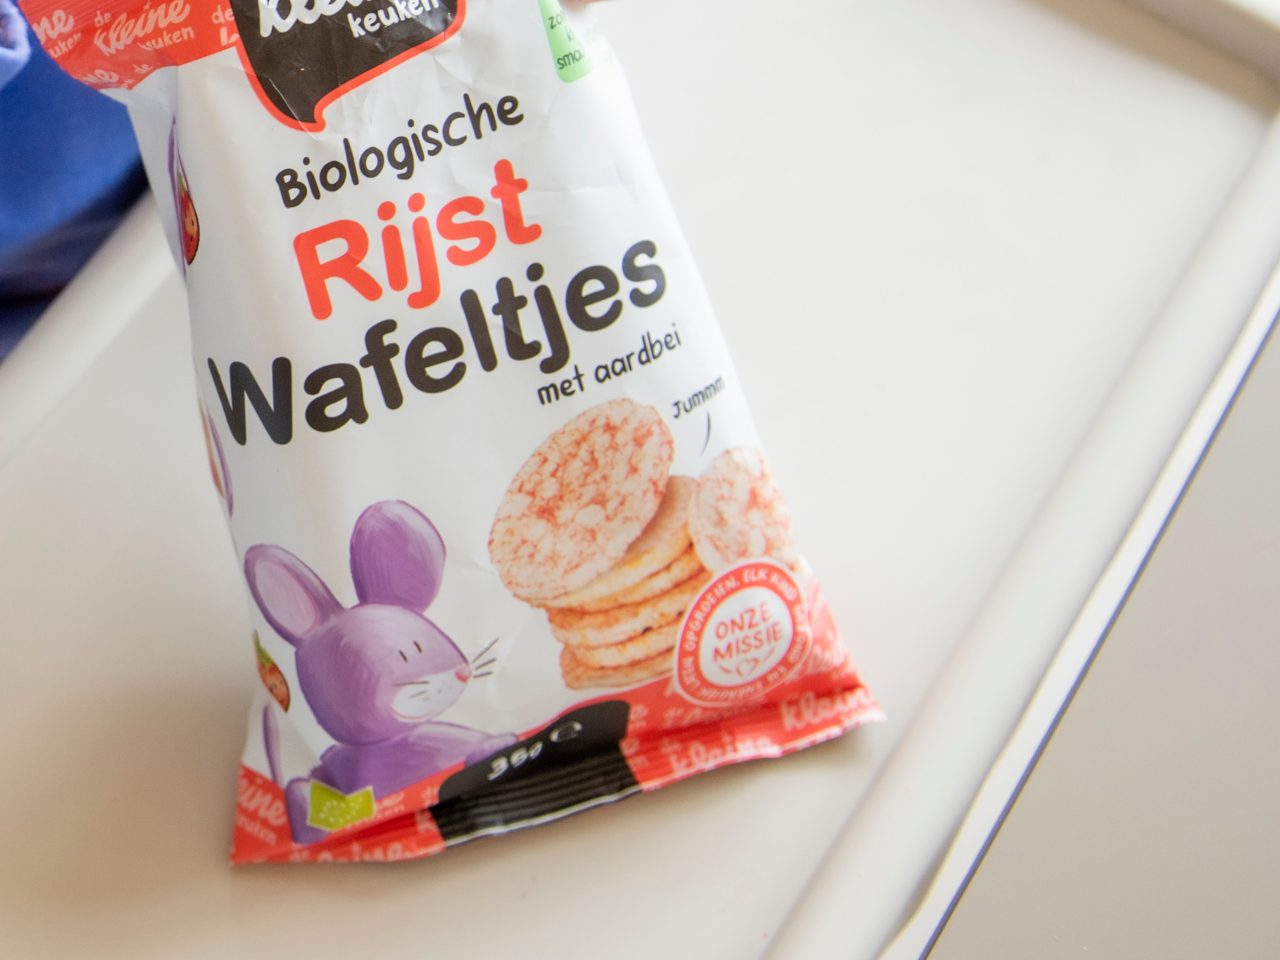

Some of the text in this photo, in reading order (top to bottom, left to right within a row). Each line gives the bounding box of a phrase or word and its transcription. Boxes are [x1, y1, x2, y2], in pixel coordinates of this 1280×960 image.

[276, 93, 524, 209] Biologische
[293, 158, 543, 321] Rijst
[207, 239, 667, 446] Wafeltjes
[537, 322, 682, 406] met aardbei
[712, 621, 783, 662] MISSIE
[715, 602, 772, 639] ONZE
